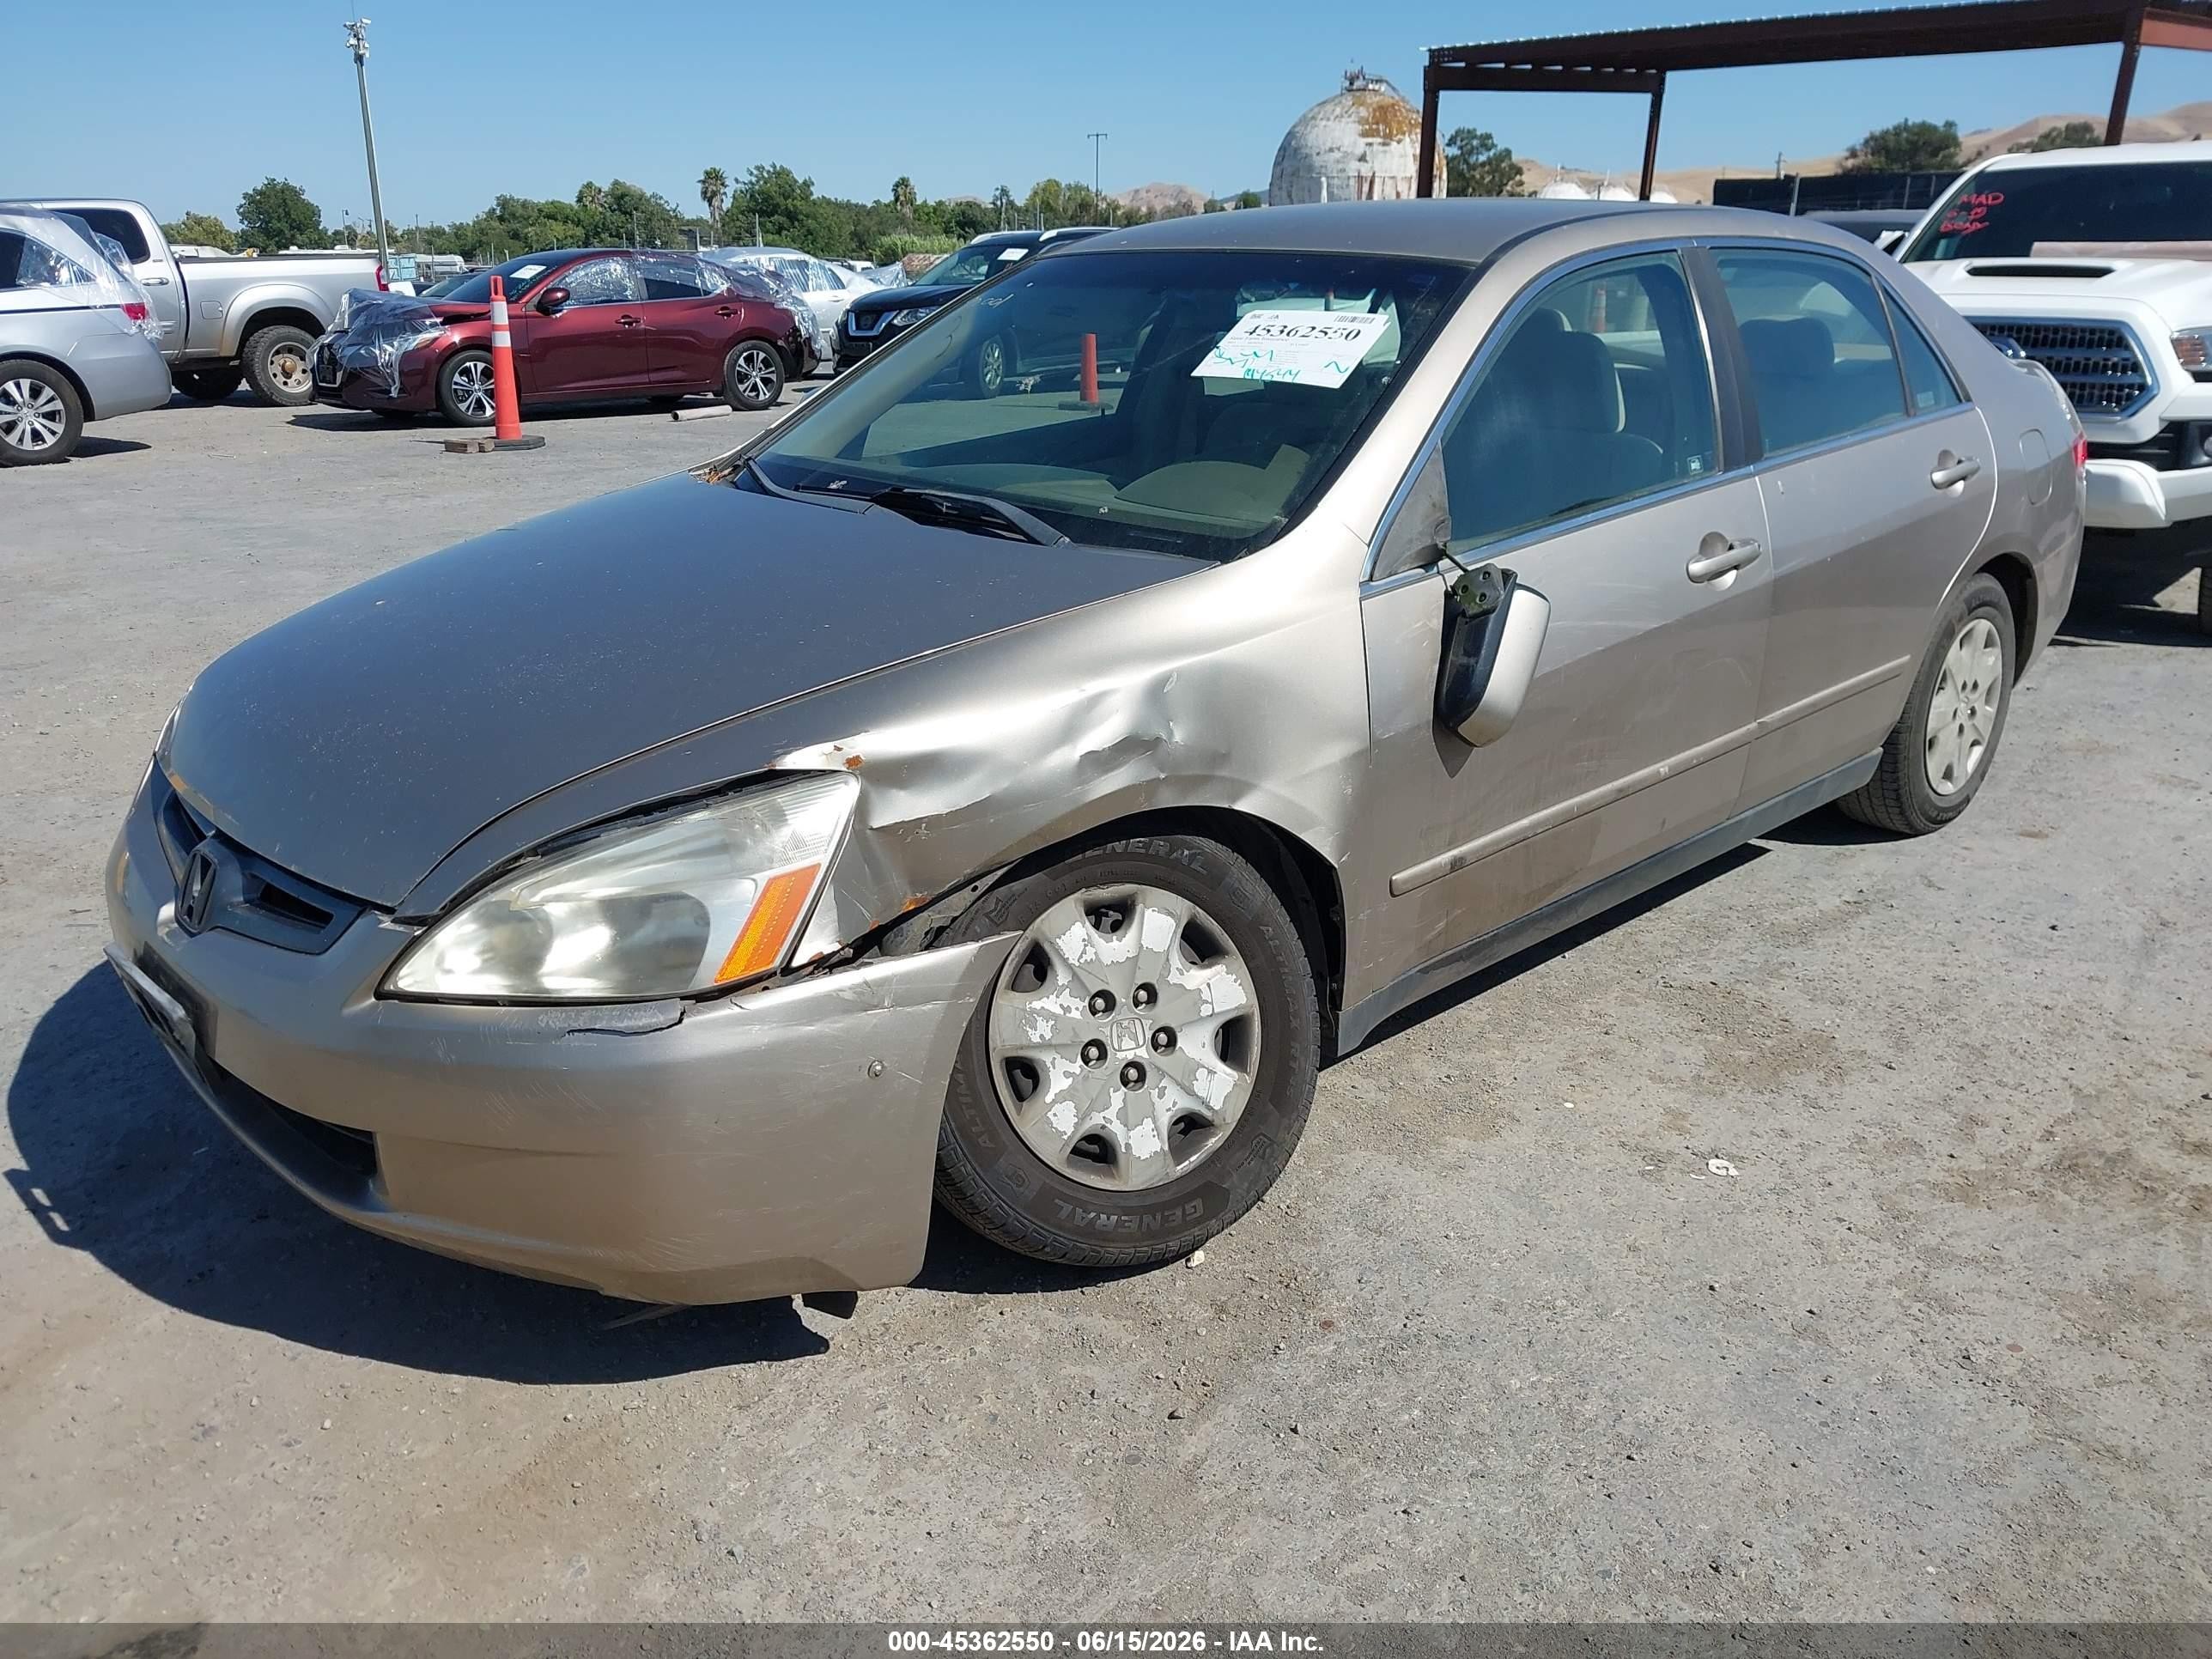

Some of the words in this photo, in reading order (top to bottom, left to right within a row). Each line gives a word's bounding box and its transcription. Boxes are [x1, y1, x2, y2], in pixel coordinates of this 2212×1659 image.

[1243, 324, 1362, 342] 45362550
[1064, 837, 1210, 876] ENERAL
[1257, 924, 1300, 1033] ALTIMAX
[1054, 1197, 1205, 1233] GENERAL
